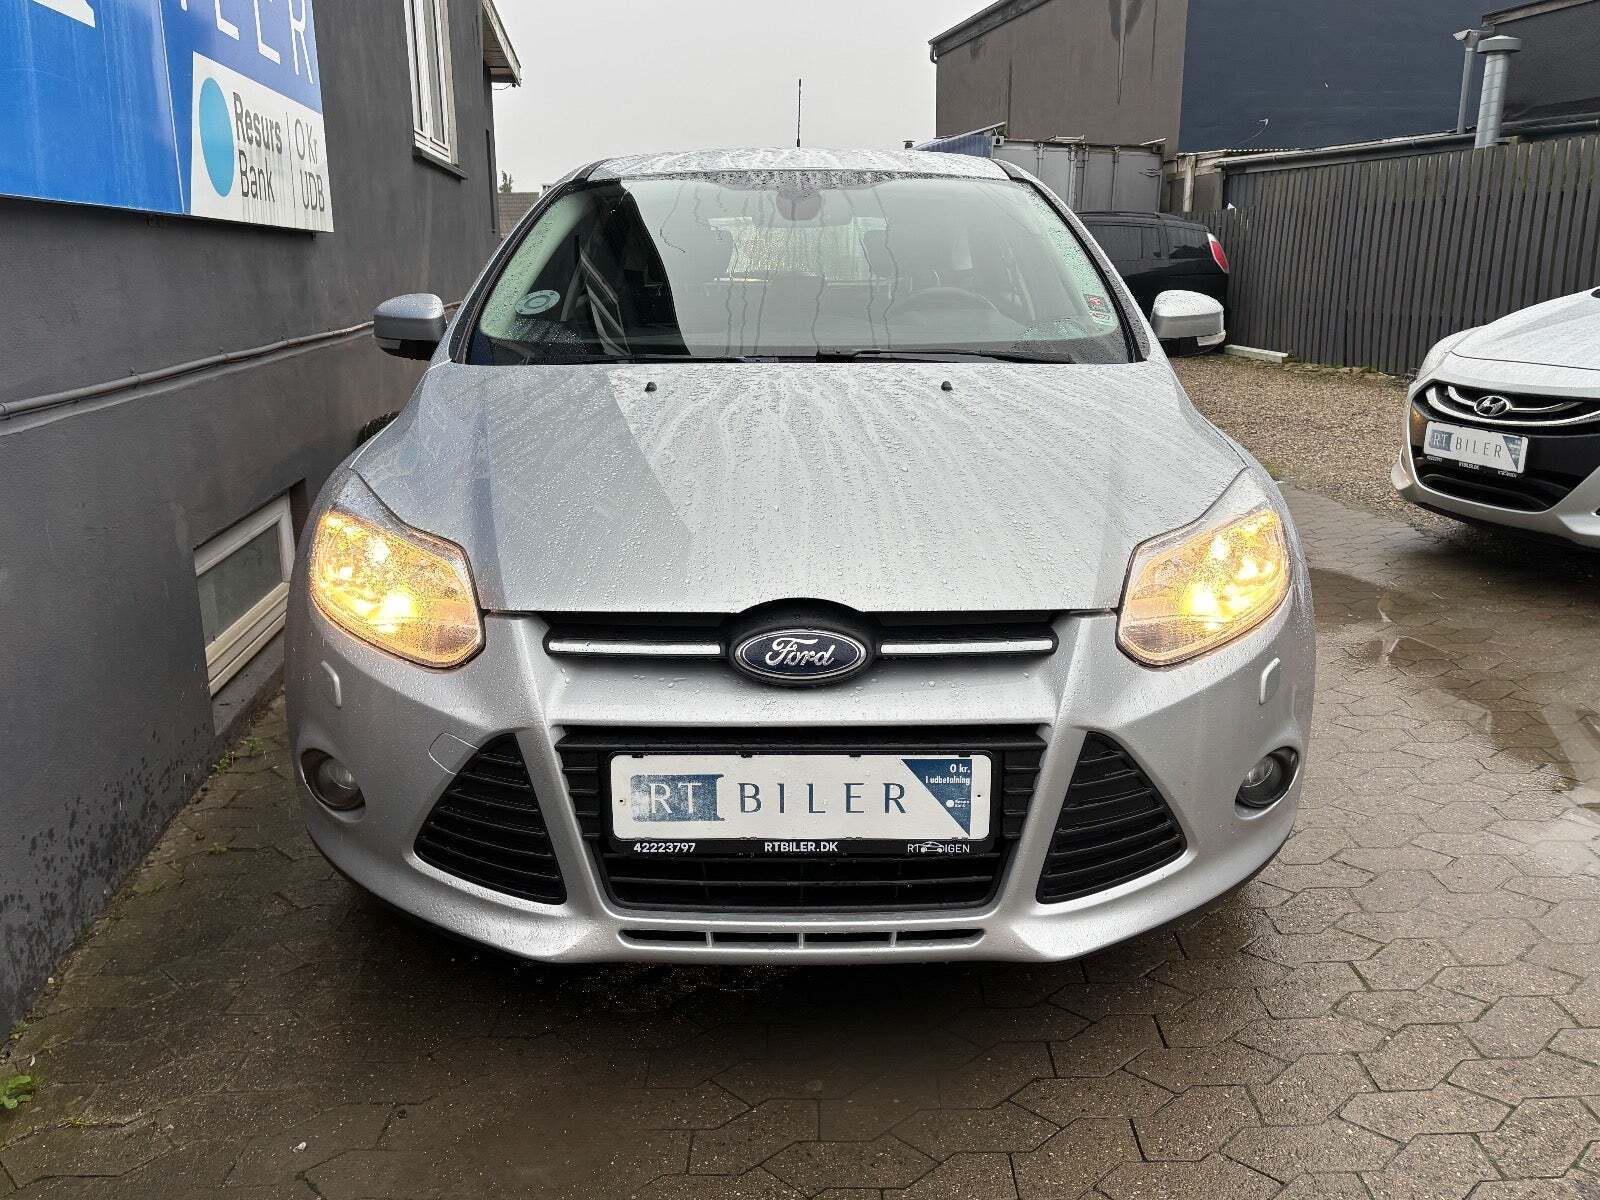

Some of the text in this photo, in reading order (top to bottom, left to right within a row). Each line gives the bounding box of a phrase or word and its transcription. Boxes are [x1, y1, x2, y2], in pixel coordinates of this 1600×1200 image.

[233, 92, 283, 154] Resurs
[238, 149, 275, 202] Bank
[299, 169, 325, 212] UDB
[1456, 437, 1502, 458] BILER
[765, 637, 836, 666] Ford
[950, 764, 971, 773] 0 kr.
[649, 783, 907, 814] RT BILER
[633, 842, 696, 853] 42223797
[764, 841, 839, 853] RTBILER.DK
